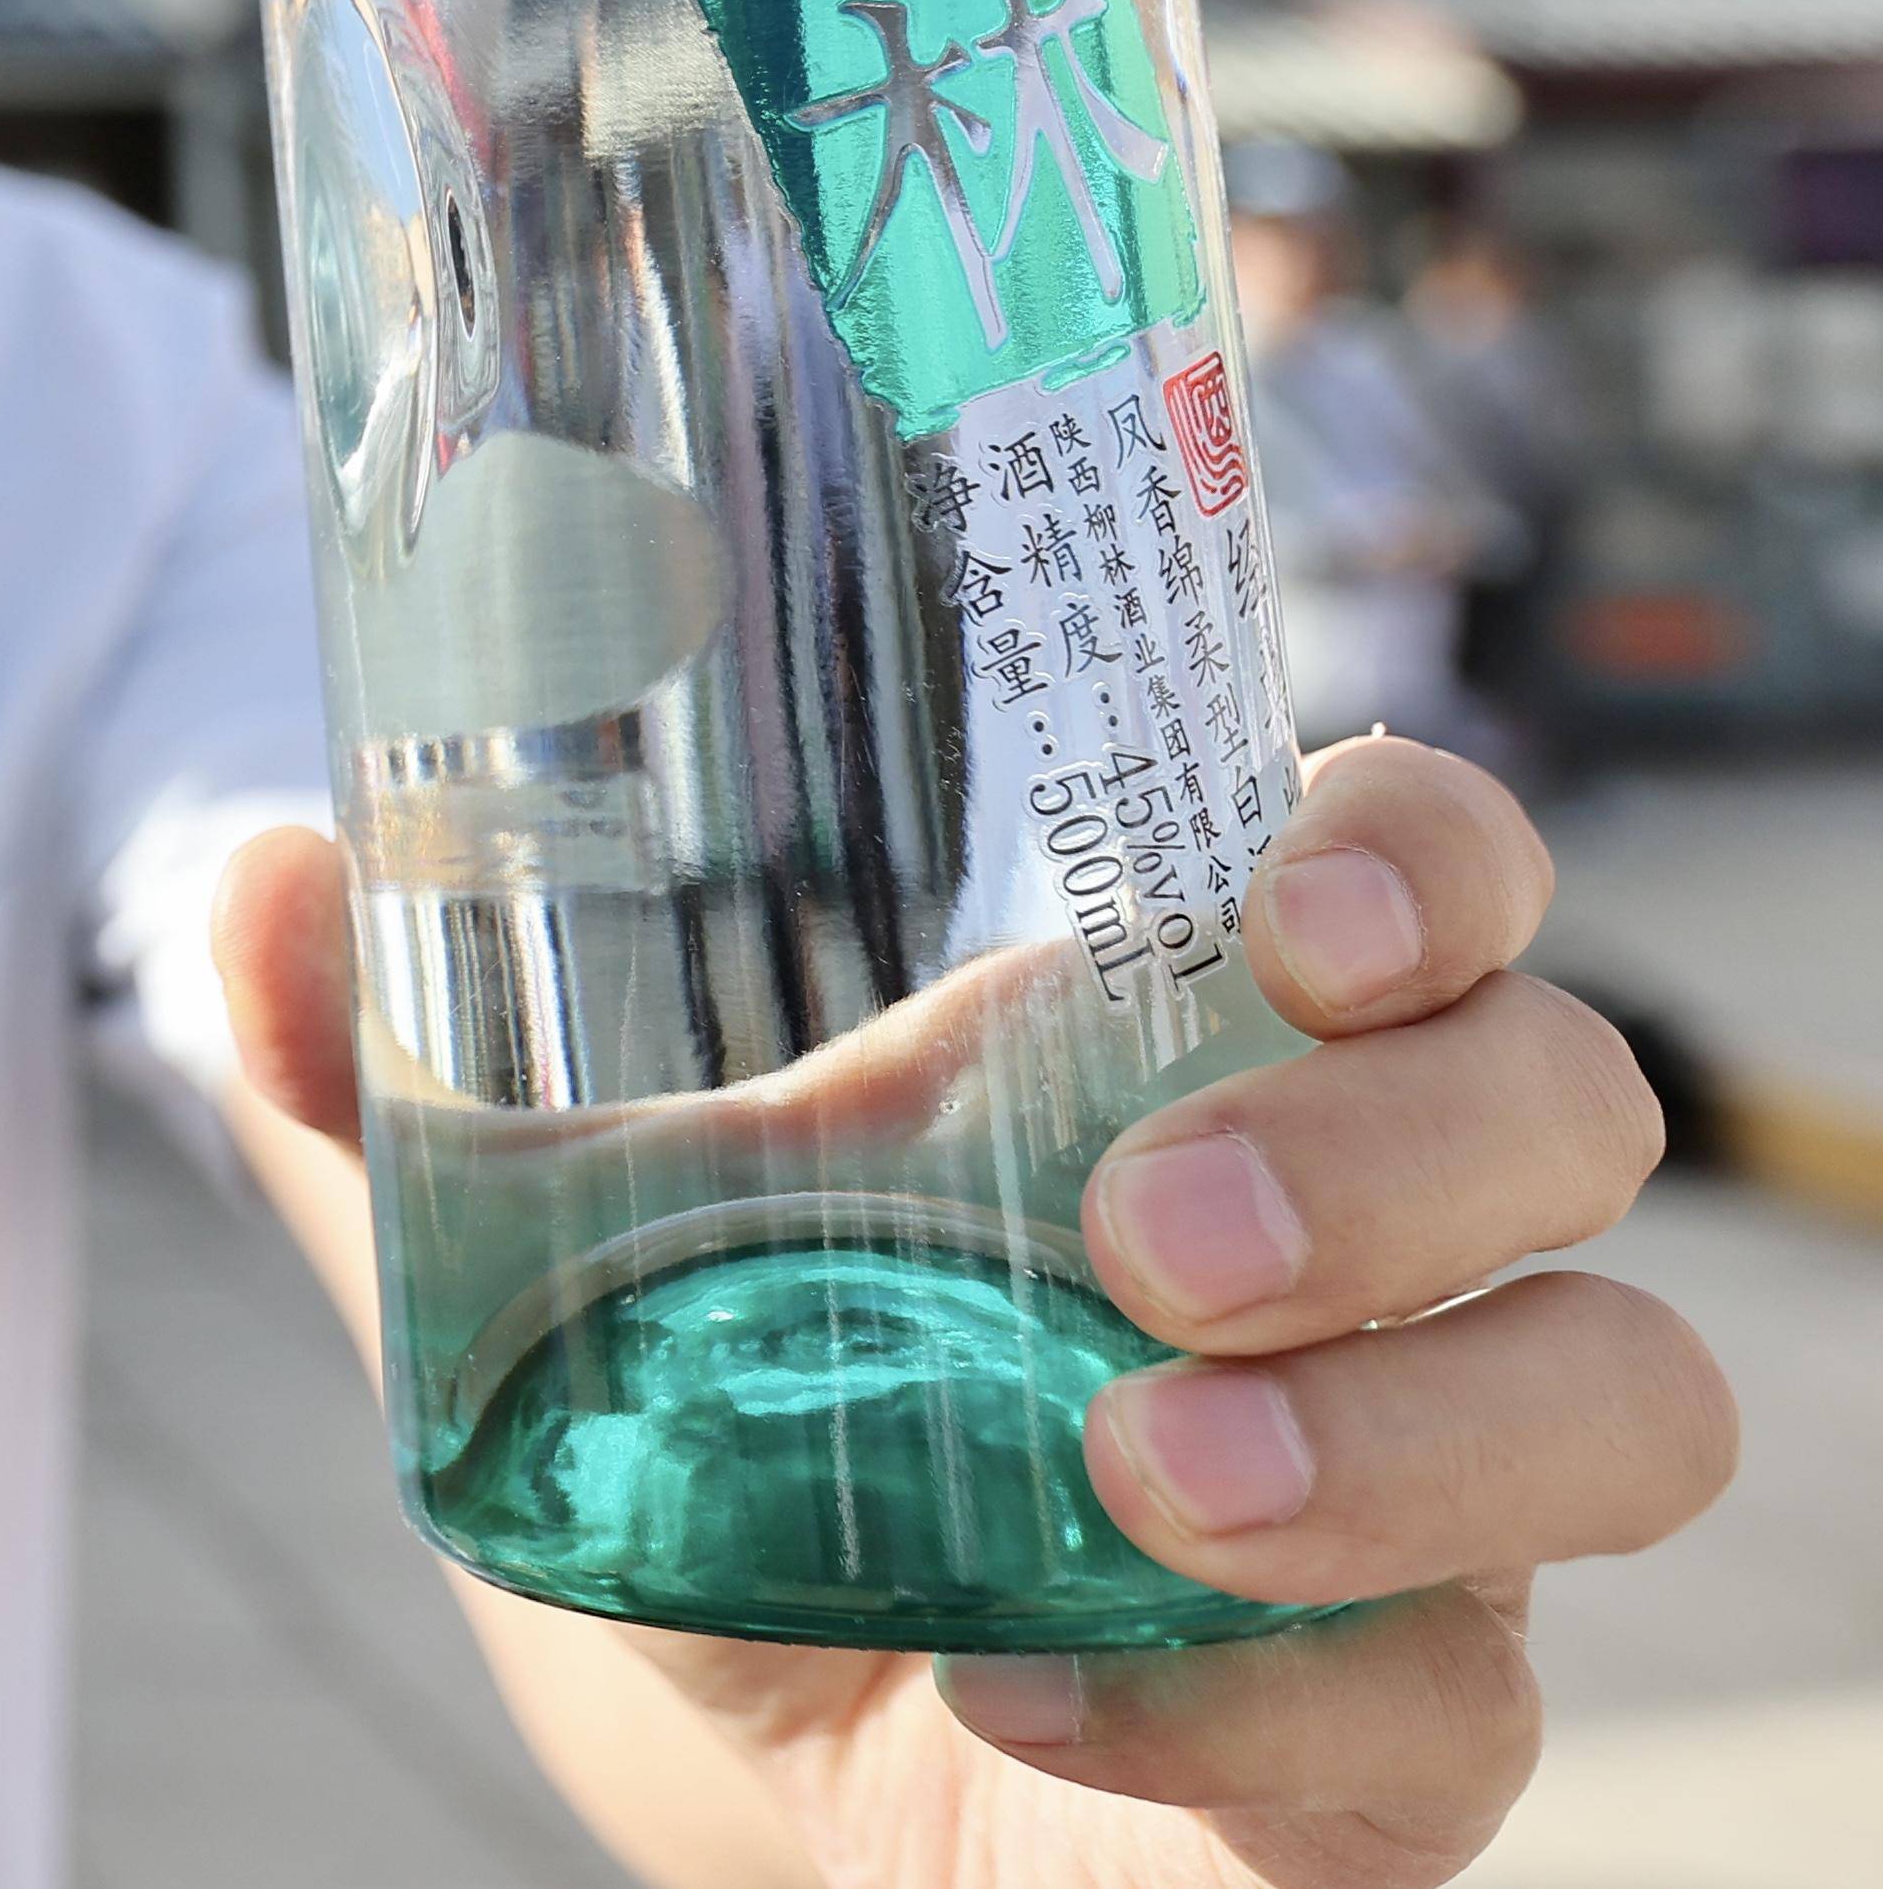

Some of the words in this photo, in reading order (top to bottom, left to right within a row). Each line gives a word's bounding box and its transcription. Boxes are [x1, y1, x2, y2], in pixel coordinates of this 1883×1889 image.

[1048, 413, 1241, 934] 陕西柳林酒业集团有限公司
[1107, 394, 1275, 874] 凤香绵柔型白
